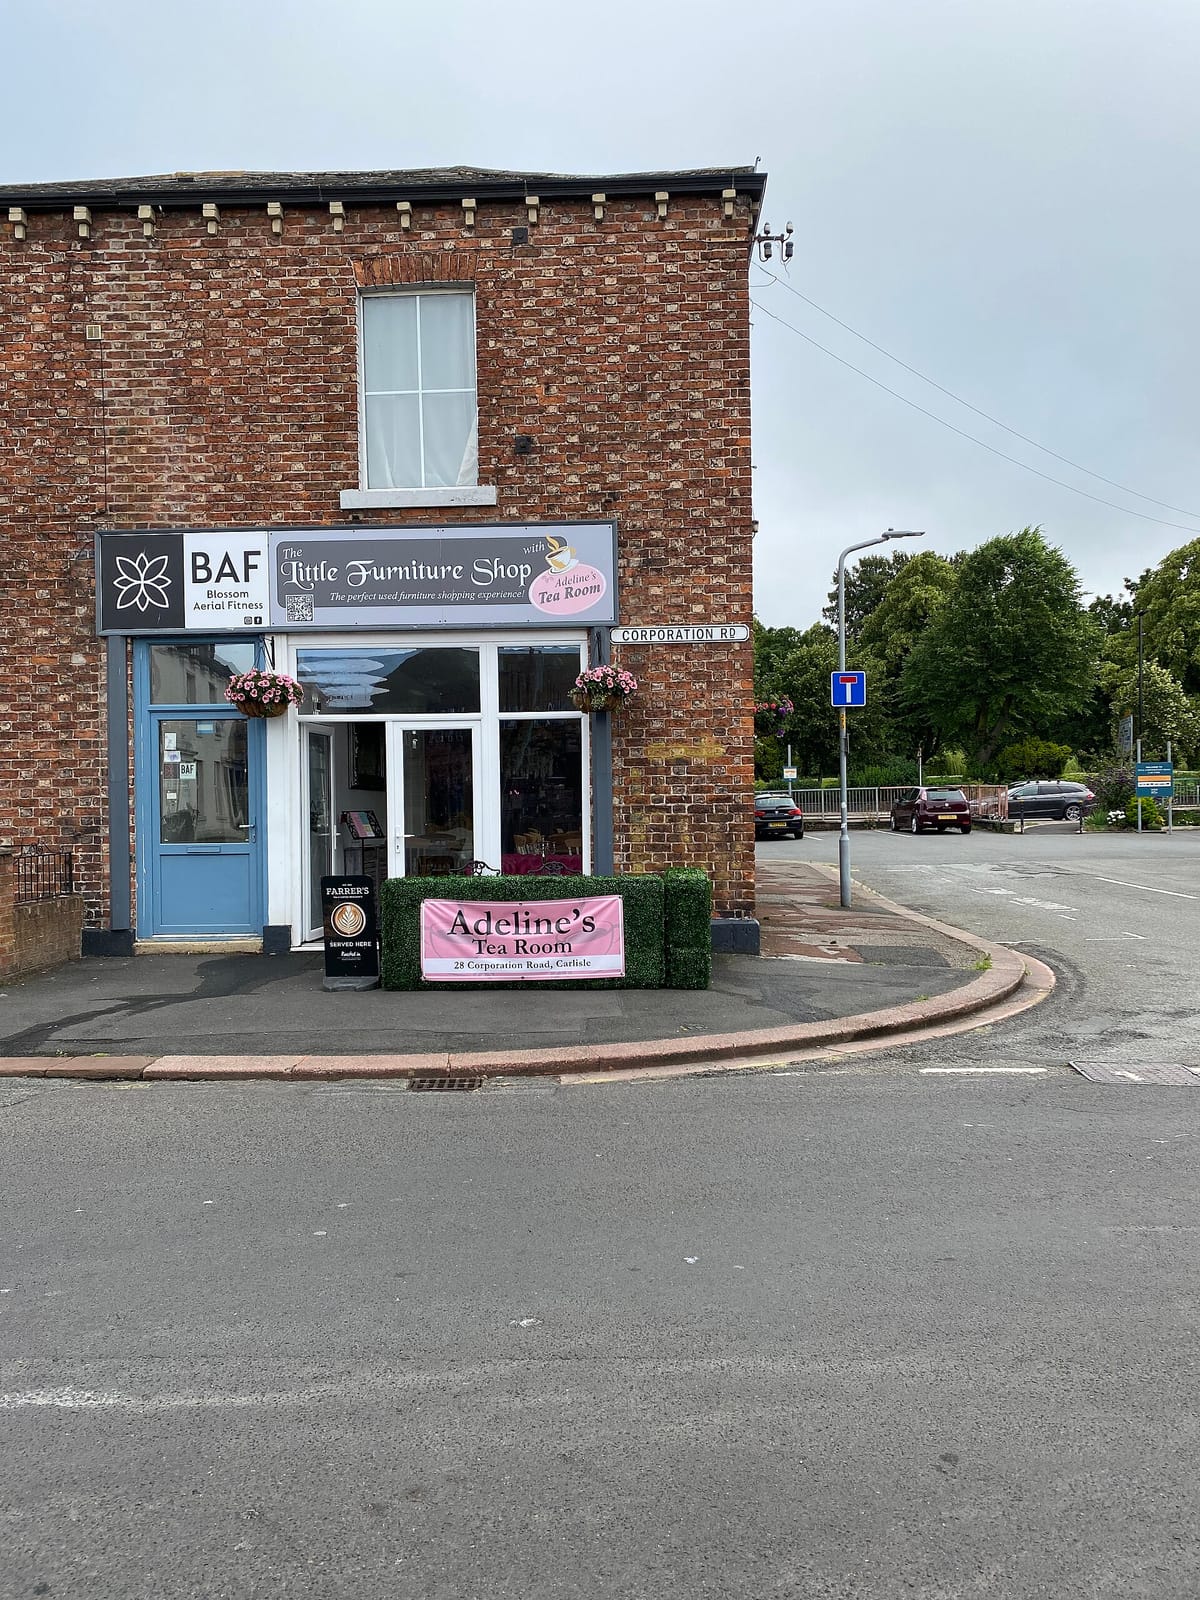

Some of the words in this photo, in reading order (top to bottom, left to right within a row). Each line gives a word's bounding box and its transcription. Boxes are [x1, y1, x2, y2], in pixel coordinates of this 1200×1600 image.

[282, 547, 303, 559] The
[522, 541, 545, 554] with
[191, 550, 261, 584] BAF
[280, 560, 339, 590] Little
[345, 559, 464, 587] Furniture
[470, 557, 532, 587] Shop
[554, 571, 597, 588] Adeline's
[206, 589, 249, 599] Blossom
[330, 592, 346, 601] The
[347, 591, 377, 602] perfect
[378, 591, 399, 600] used
[398, 591, 436, 602] furniture
[437, 589, 475, 601] shopping
[477, 589, 525, 601] experience!
[538, 591, 560, 604] Tea
[564, 583, 601, 600] Room
[193, 600, 225, 611] Aerial
[227, 600, 264, 611] Fitness
[622, 628, 713, 641] CORPORATION
[720, 628, 736, 638] RD
[180, 764, 194, 774] BAF
[326, 886, 370, 895] FARRER'S
[447, 908, 596, 936] Adeline's
[472, 938, 507, 955] Tea
[514, 939, 572, 955] Room
[454, 961, 465, 969] 28
[467, 960, 523, 971] Corporation
[526, 960, 553, 970] Road,
[556, 959, 592, 968] Carlisle
